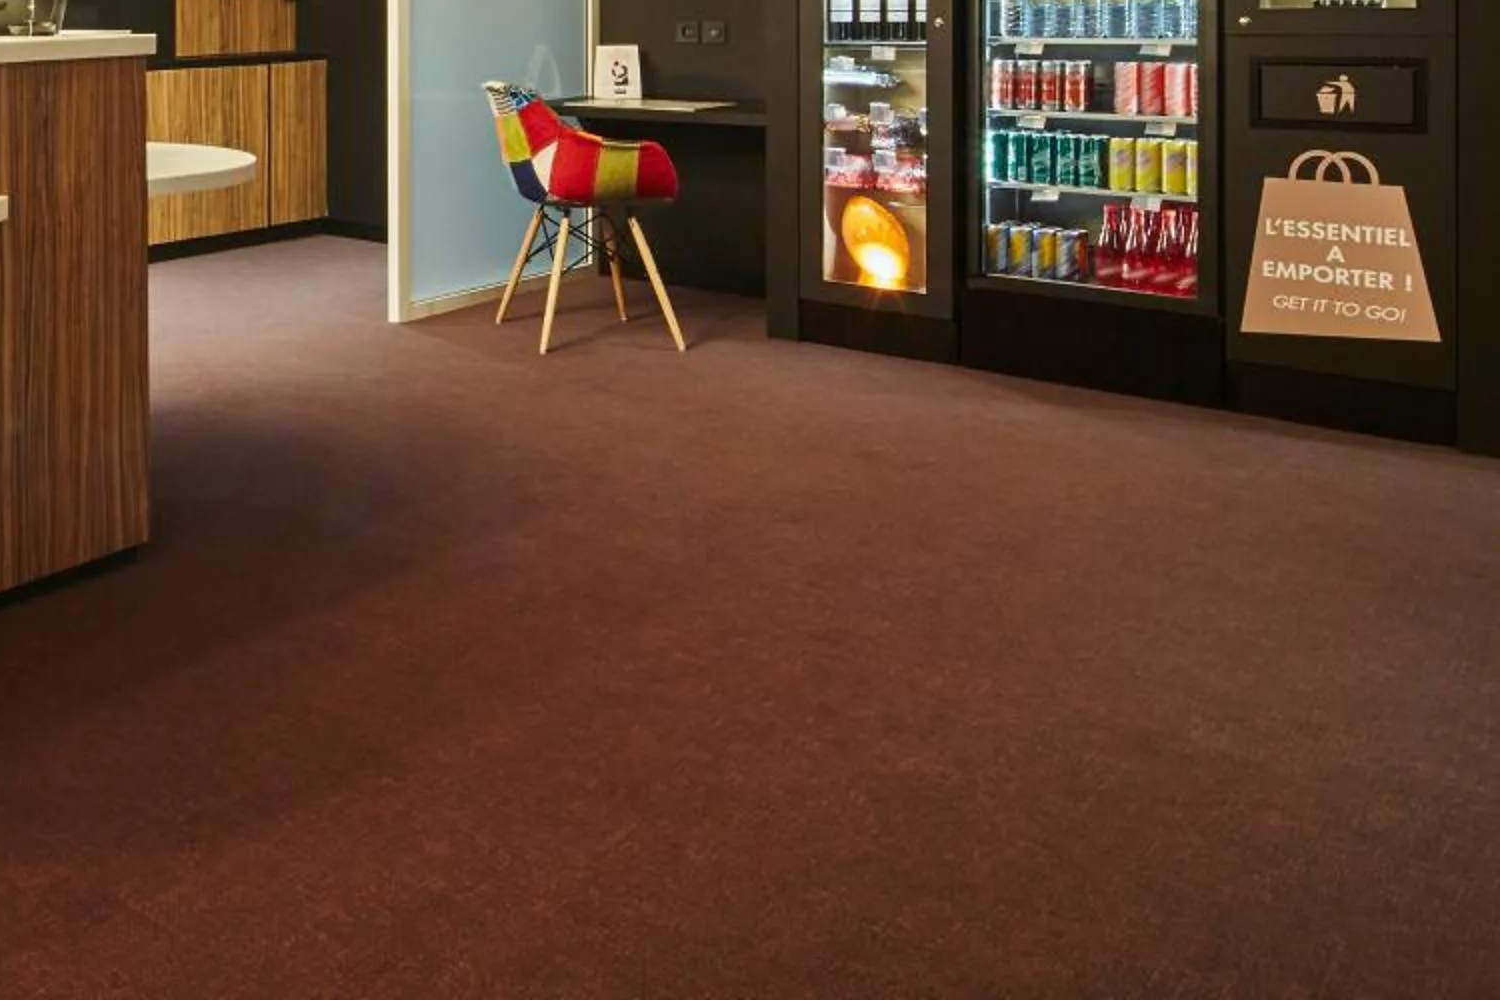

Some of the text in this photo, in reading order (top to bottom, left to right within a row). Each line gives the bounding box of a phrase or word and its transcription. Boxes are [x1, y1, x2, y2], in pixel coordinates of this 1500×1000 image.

[1264, 217, 1411, 247] L'ESSENTIEL
[1326, 245, 1345, 263] A
[1262, 261, 1413, 292] EMPORTER !
[1272, 295, 1407, 323] GET IT TO GO!
